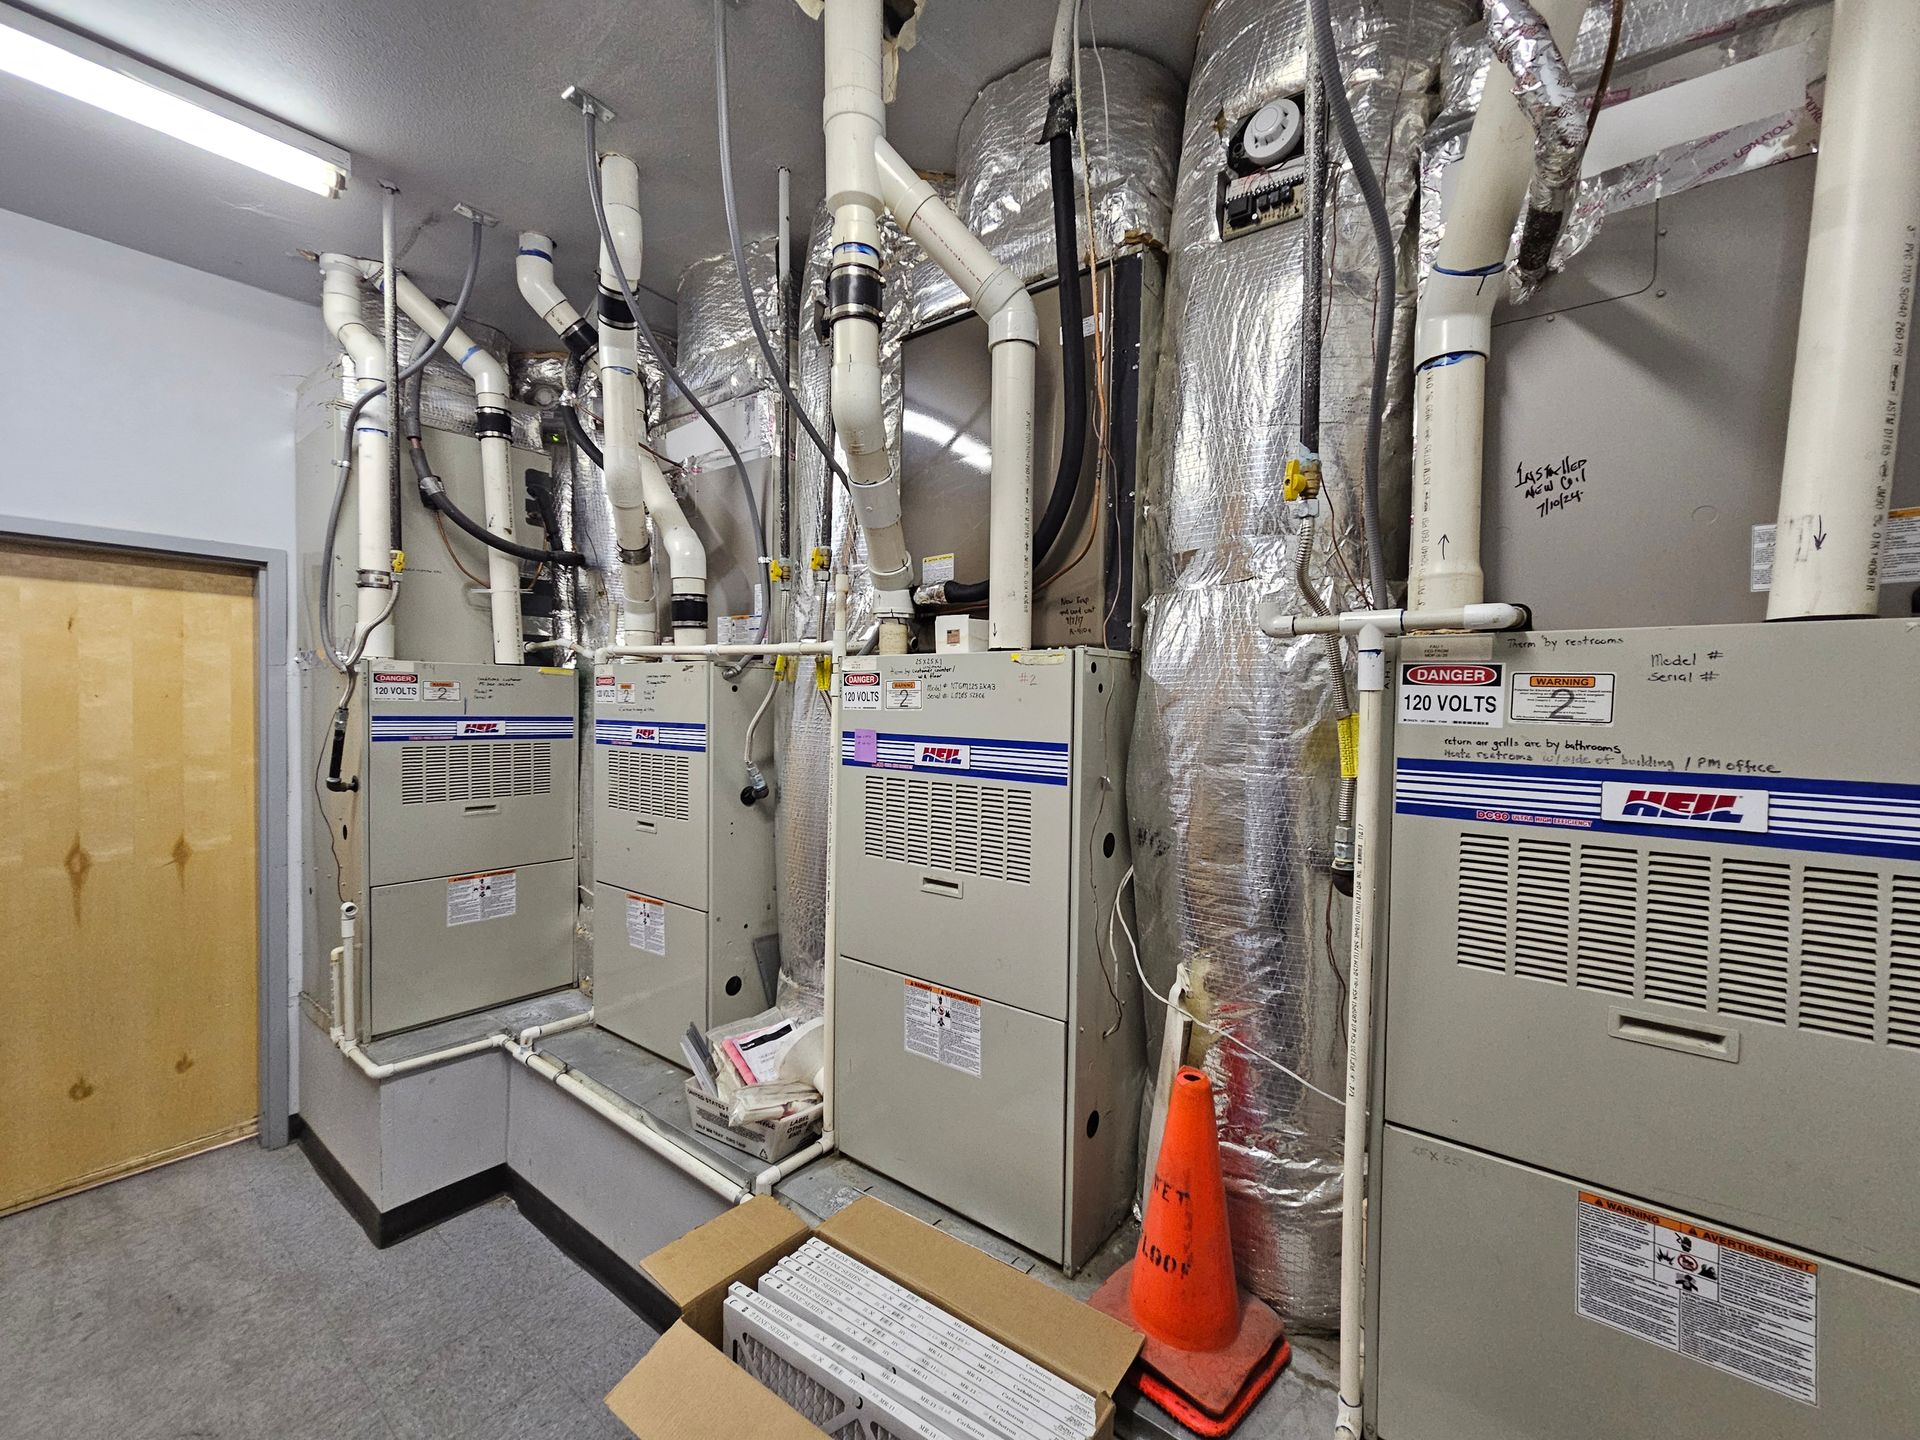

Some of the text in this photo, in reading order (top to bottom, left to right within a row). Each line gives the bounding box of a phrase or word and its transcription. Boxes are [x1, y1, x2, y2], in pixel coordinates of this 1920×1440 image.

[1651, 650, 1724, 668] Model #
[848, 675, 875, 684] DANGER
[1417, 669, 1486, 681] DANGER
[1536, 678, 1589, 686] WARNING
[1700, 671, 1720, 682] #
[374, 686, 417, 695] 120 VOLTS
[438, 687, 447, 700] 2
[844, 691, 880, 702] 120 VOLTS
[899, 689, 909, 707] 2
[1404, 694, 1432, 711] 120
[1437, 694, 1497, 713] VOLTS
[1549, 688, 1574, 719] 2
[1546, 739, 1560, 755] by
[1564, 739, 1622, 754] bathrooms
[922, 747, 962, 765] HEIL
[1622, 789, 1744, 824] HEIL
[1476, 810, 1593, 828] DC90 ULTRA HIGH EFFICIENCY
[1606, 1201, 1661, 1224] WARNING
[1703, 1232, 1811, 1272] AVERTISSEMENT
[840, 1267, 862, 1282] SERIES
[849, 1260, 869, 1275] SERIES
[820, 1281, 842, 1297] SERIES
[832, 1275, 854, 1291] SERIES
[812, 1290, 834, 1307] SERIES
[772, 1306, 793, 1322] SERIES
[802, 1299, 824, 1316] SERIES
[767, 1324, 790, 1341] SERIES
